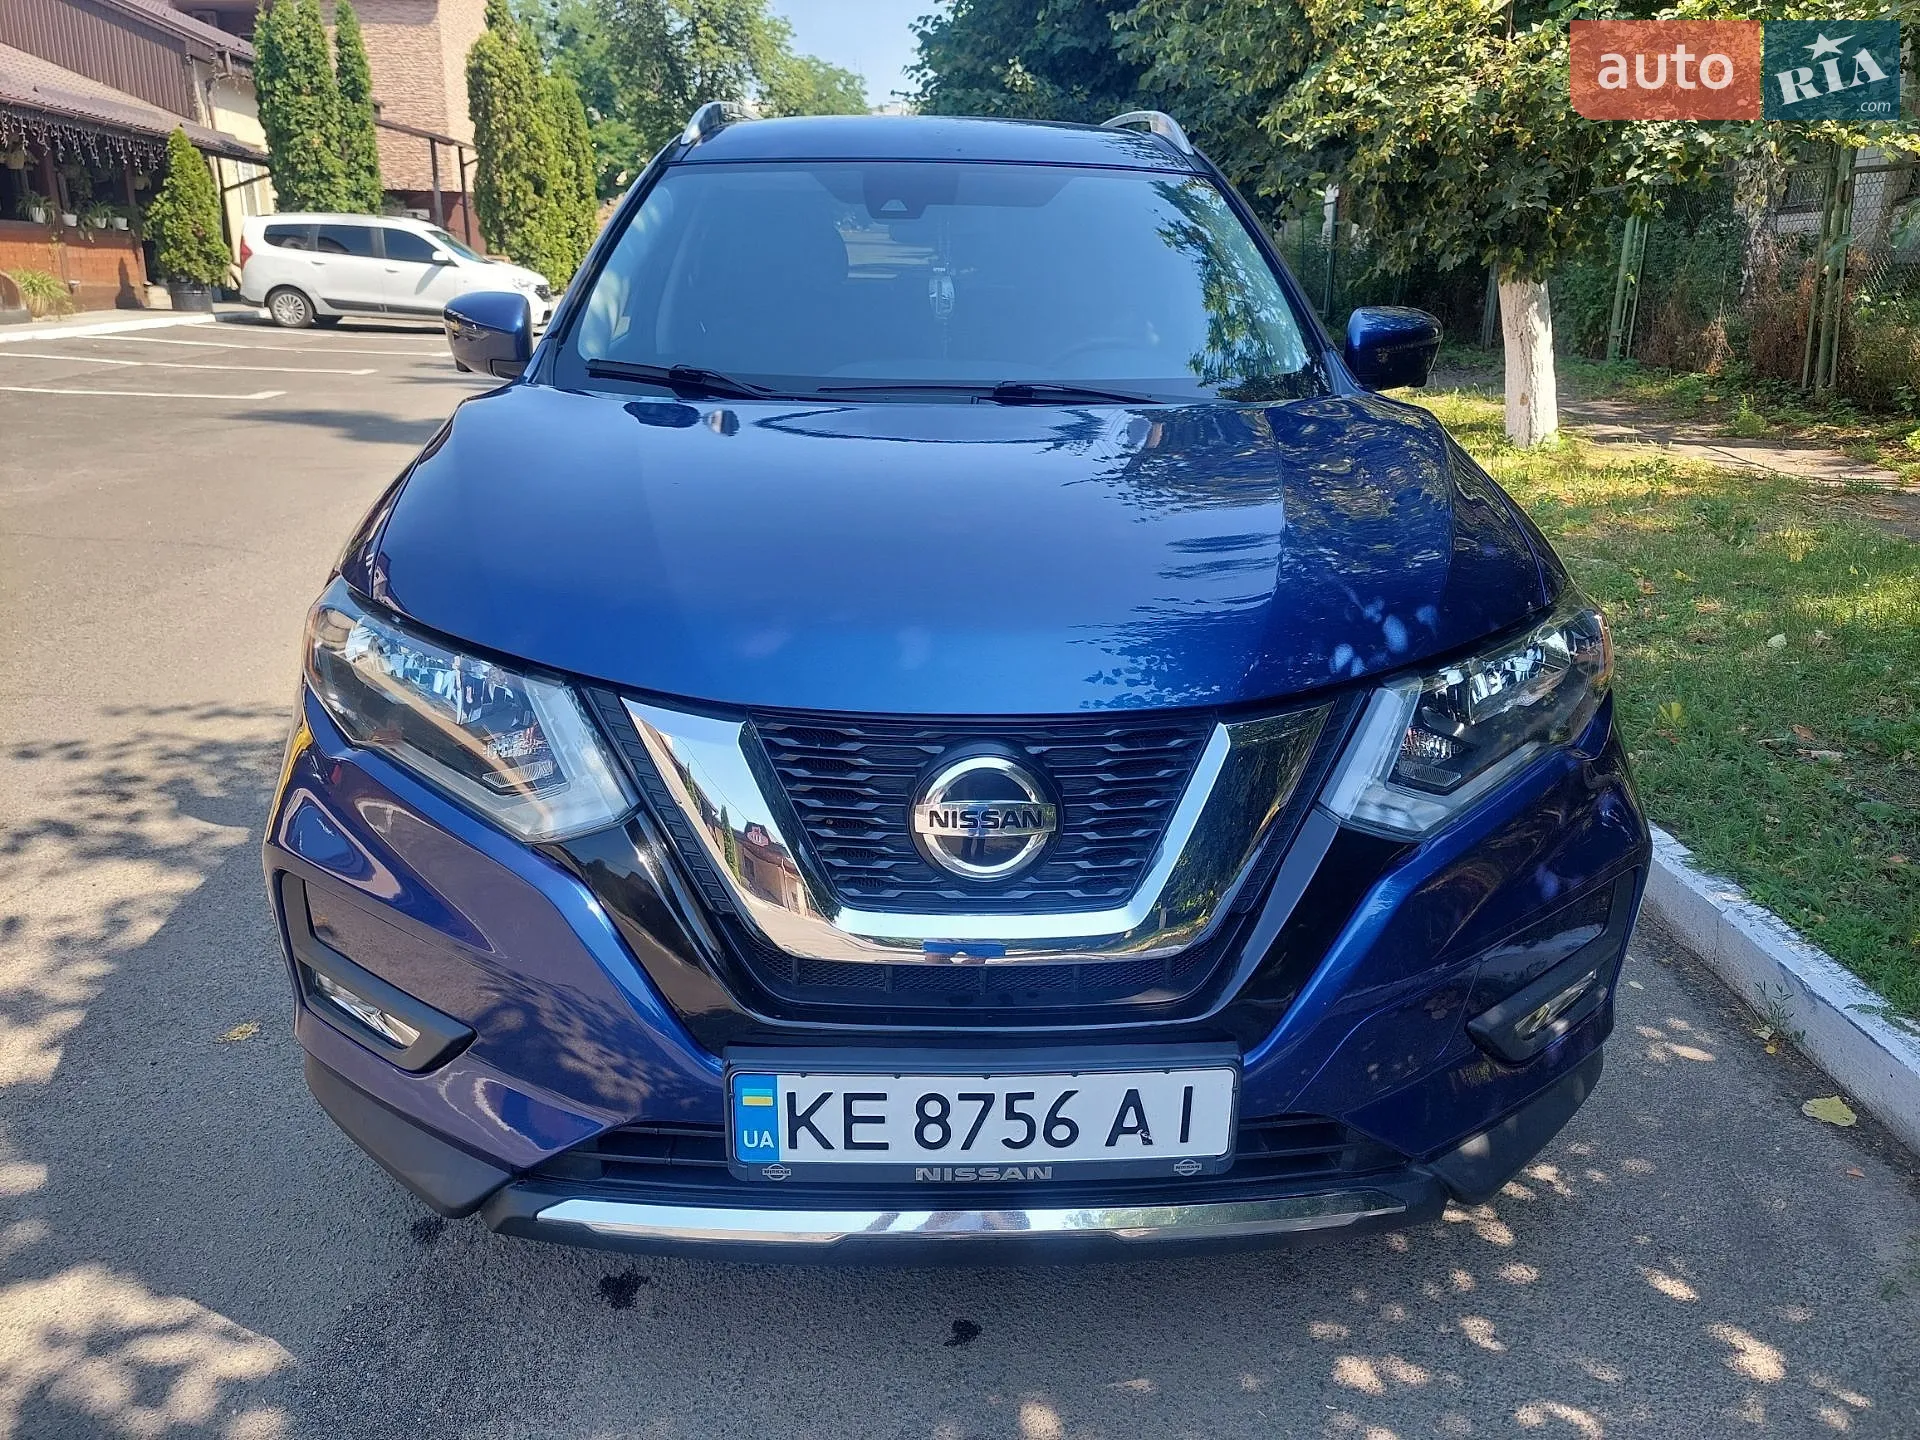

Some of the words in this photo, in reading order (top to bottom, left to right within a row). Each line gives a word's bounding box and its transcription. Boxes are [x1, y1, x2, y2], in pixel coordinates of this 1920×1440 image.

[928, 810, 1043, 829] NISSAN
[785, 1091, 890, 1151] KE
[913, 1089, 1080, 1151] 8756
[743, 1130, 775, 1148] UA
[915, 1166, 1053, 1182] NISSAN
